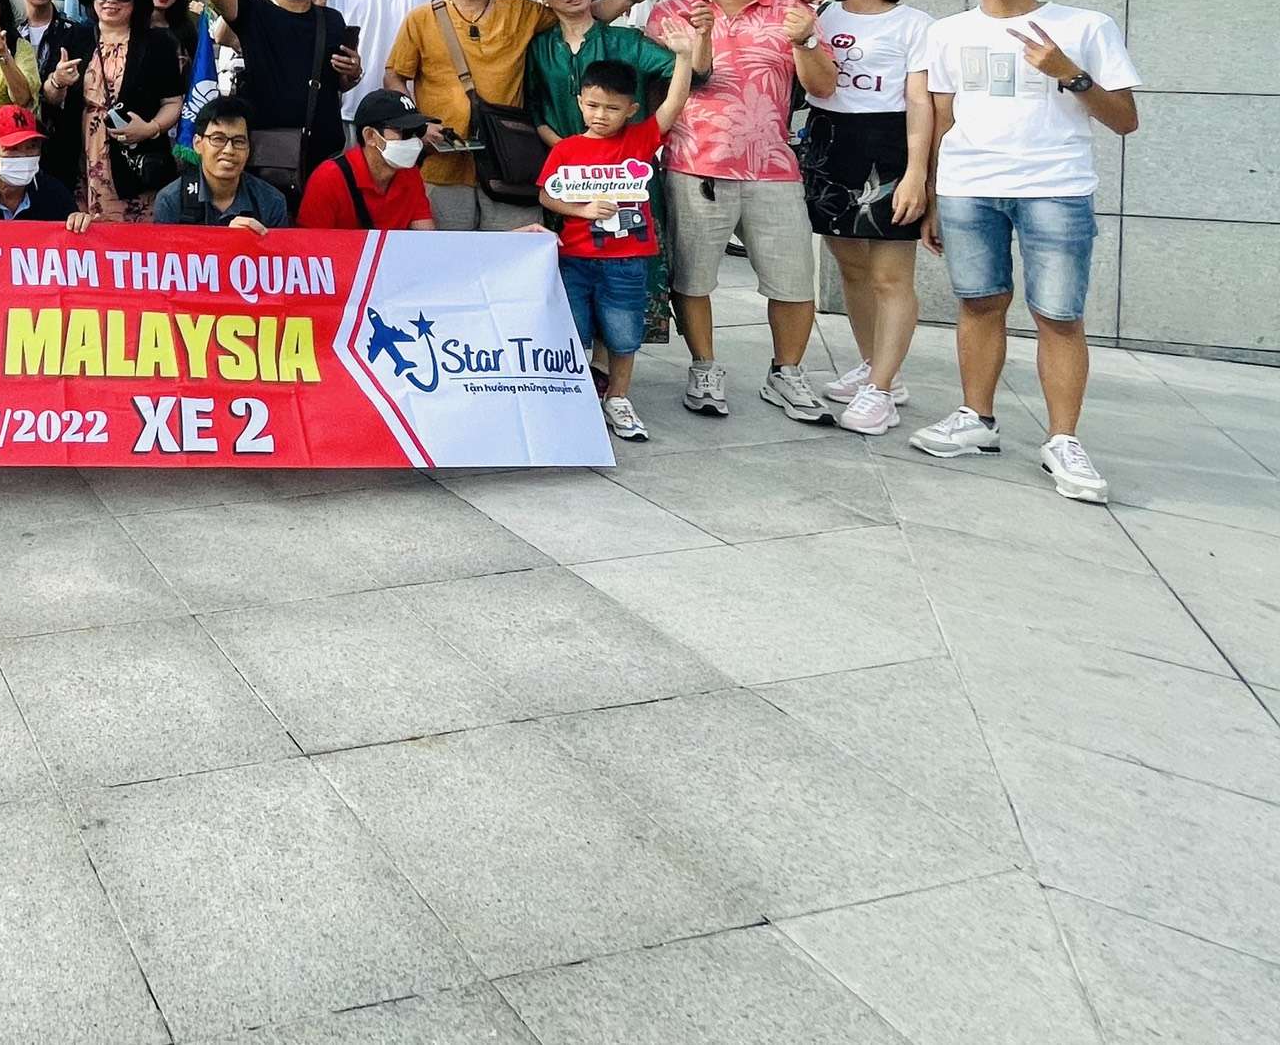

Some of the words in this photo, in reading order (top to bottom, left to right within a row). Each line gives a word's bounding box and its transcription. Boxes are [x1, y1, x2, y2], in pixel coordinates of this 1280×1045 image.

[836, 71, 882, 92] CCI
[563, 168, 569, 180] I
[580, 167, 627, 180] LOVE
[565, 180, 644, 193] vietkingtravel
[10, 247, 100, 288] NAM
[105, 250, 220, 293] THAM
[229, 254, 336, 304] QUAN
[4, 307, 322, 383] MALAYSIA
[441, 339, 504, 374] Star
[507, 337, 584, 375] Travel
[131, 395, 219, 454] XE
[230, 397, 275, 453] 2
